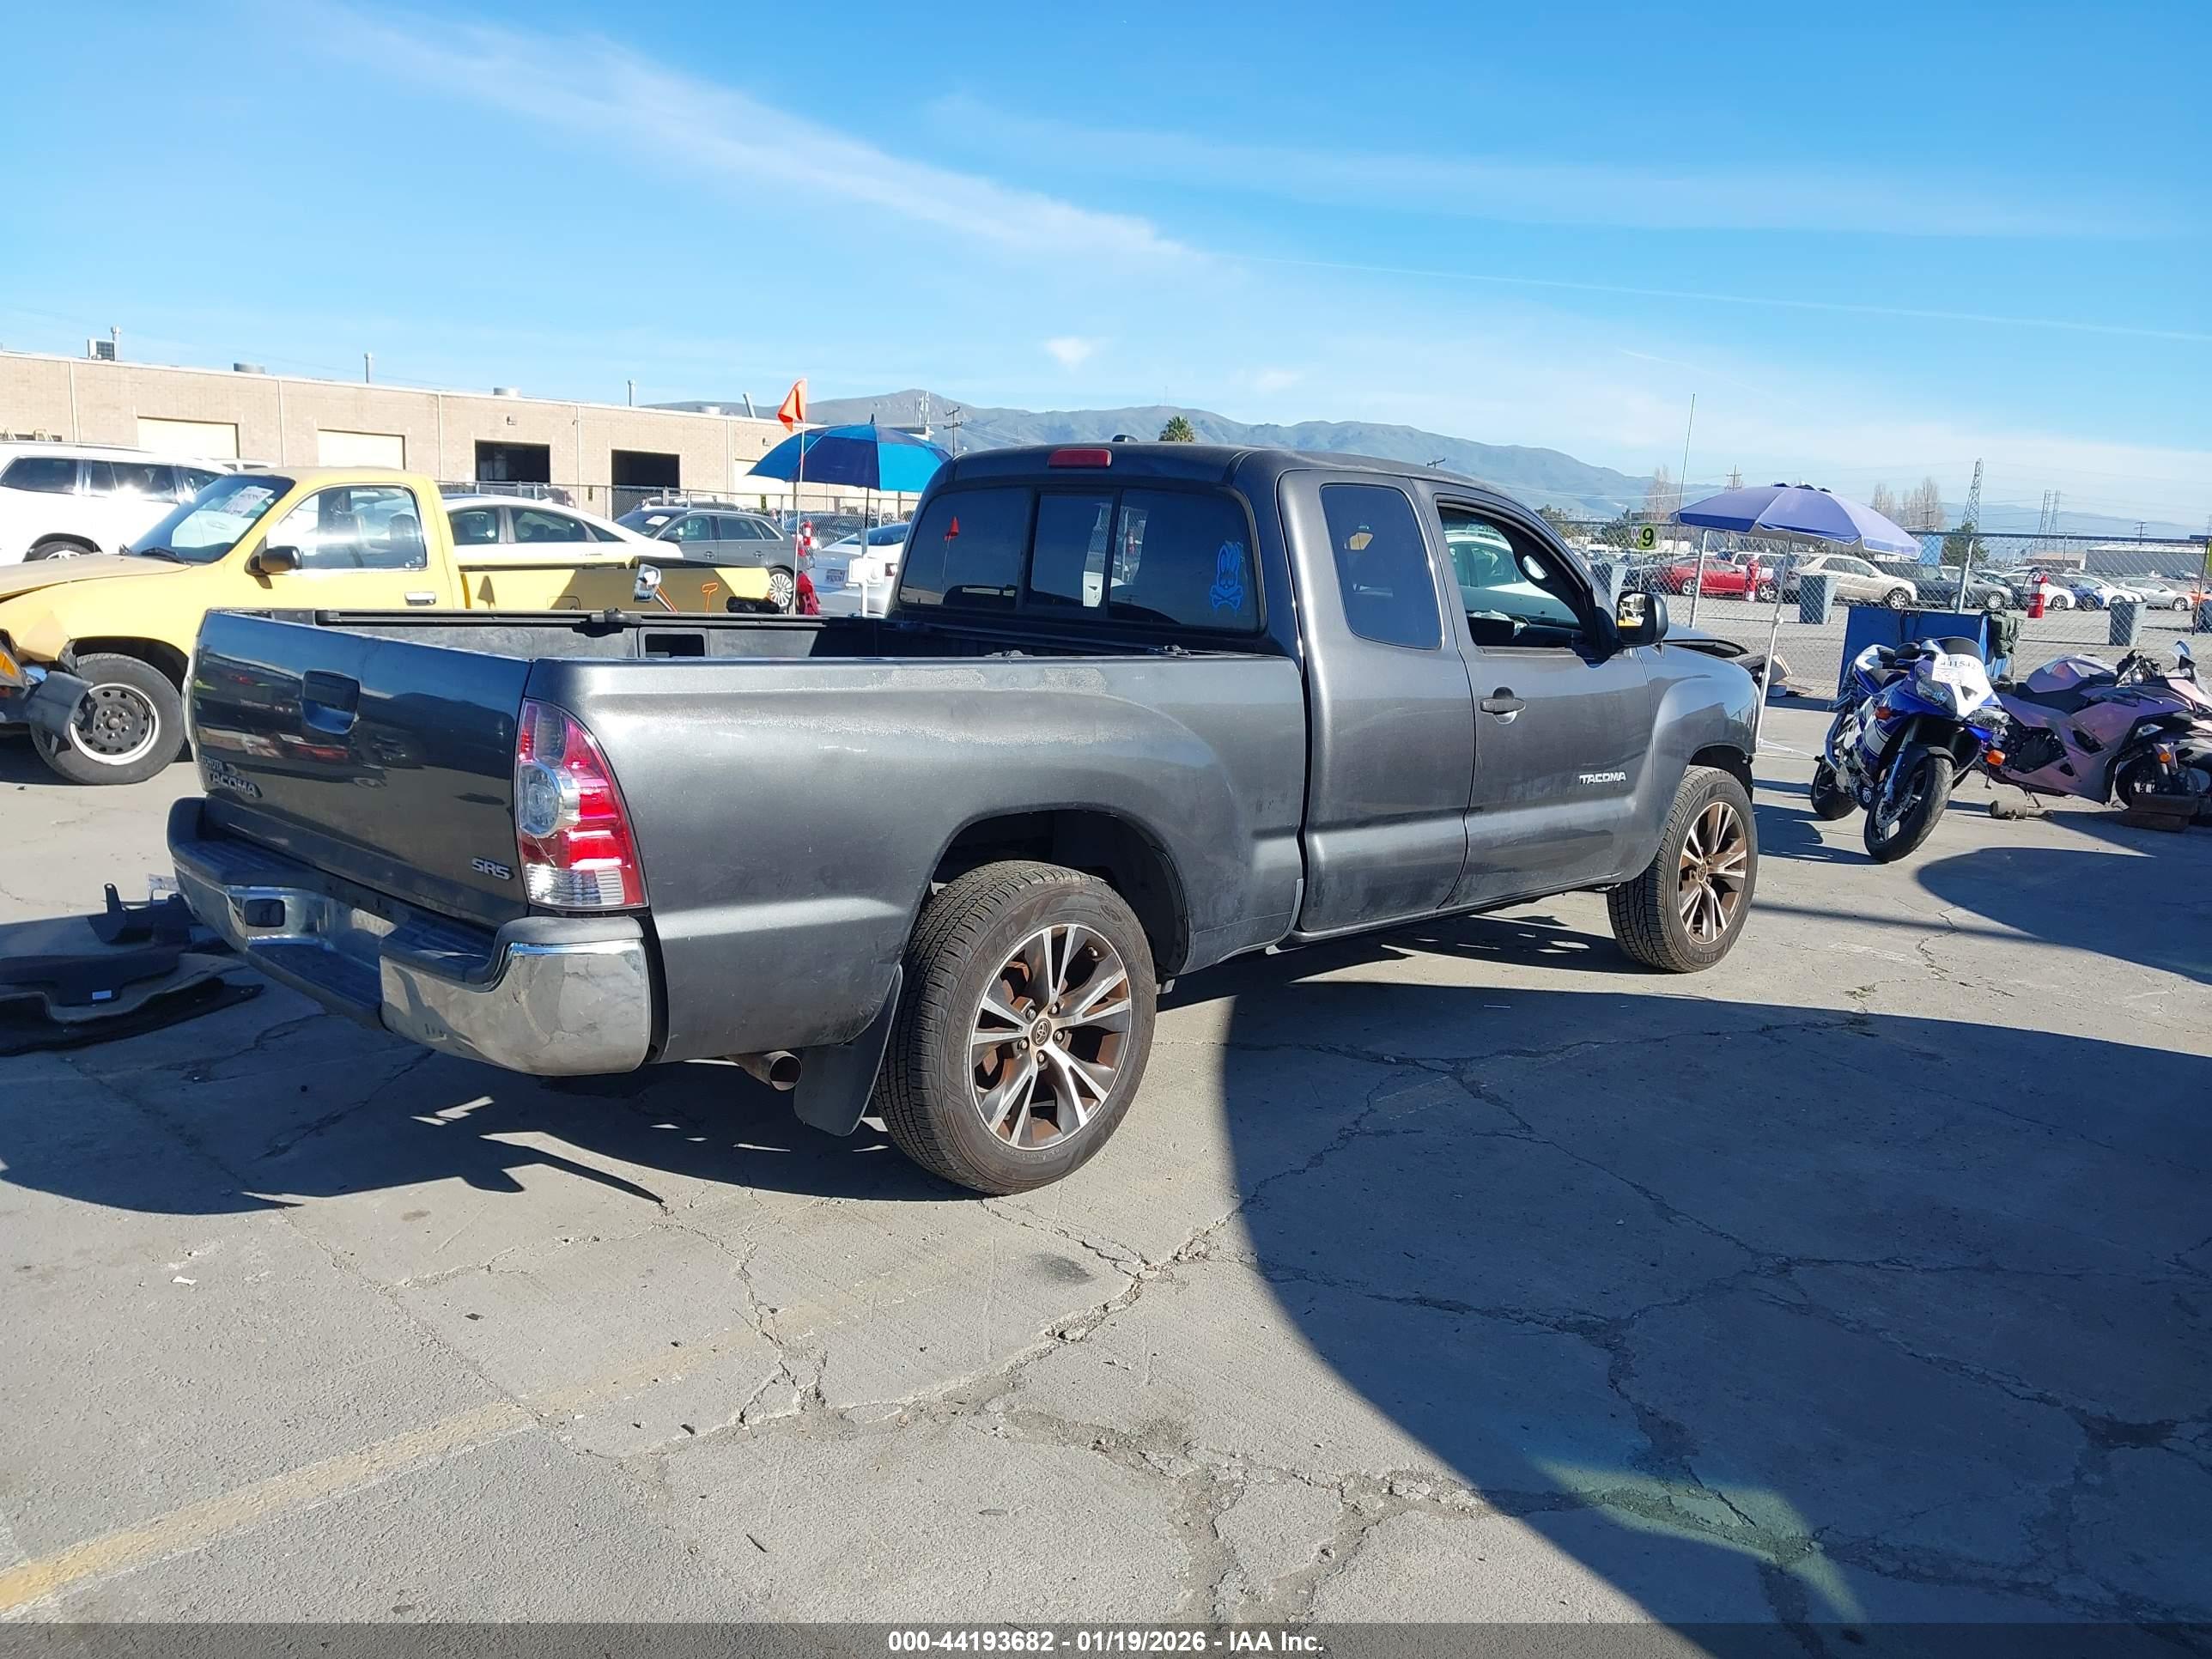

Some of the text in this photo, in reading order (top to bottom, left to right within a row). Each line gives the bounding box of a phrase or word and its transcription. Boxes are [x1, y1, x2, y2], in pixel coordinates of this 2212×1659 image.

[1642, 527, 1655, 547] 9
[206, 770, 258, 798] TACOMA
[1578, 771, 1627, 785] TACOMA
